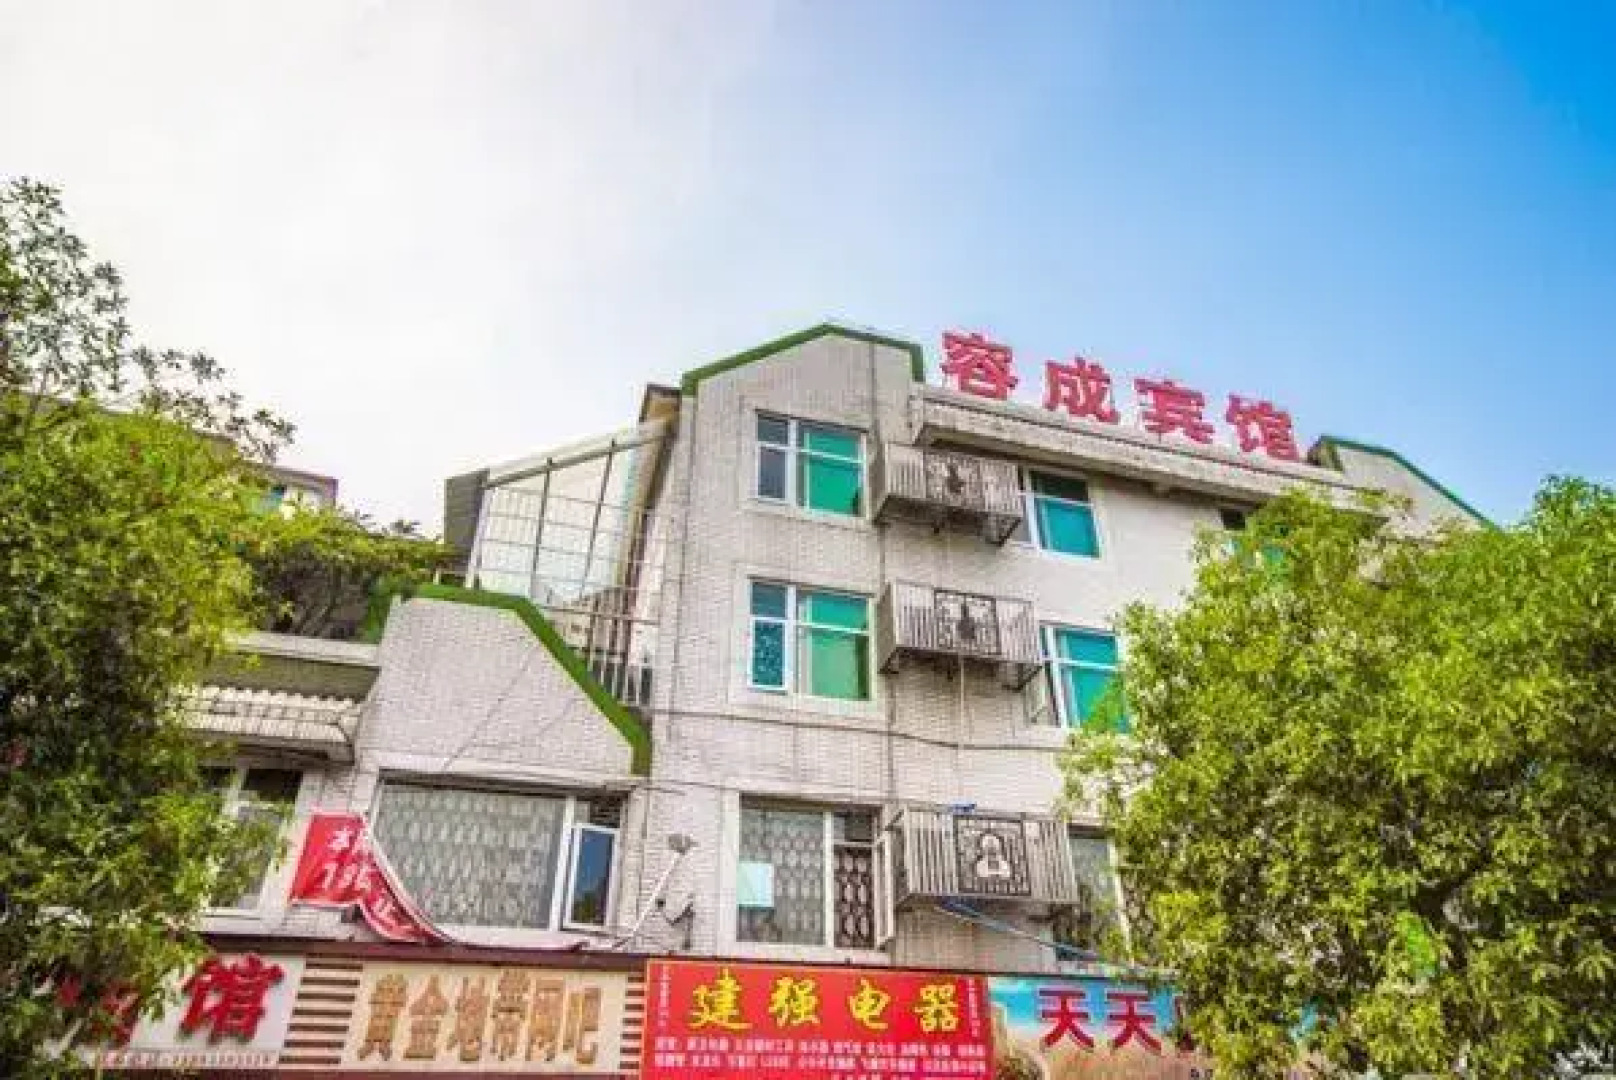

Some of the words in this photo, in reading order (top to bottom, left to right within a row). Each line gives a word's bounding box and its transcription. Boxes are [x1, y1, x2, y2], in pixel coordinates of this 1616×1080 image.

[940, 331, 1299, 461] 容成宾馆
[688, 967, 960, 1033] 建强电器
[1039, 988, 1196, 1054] 天天
